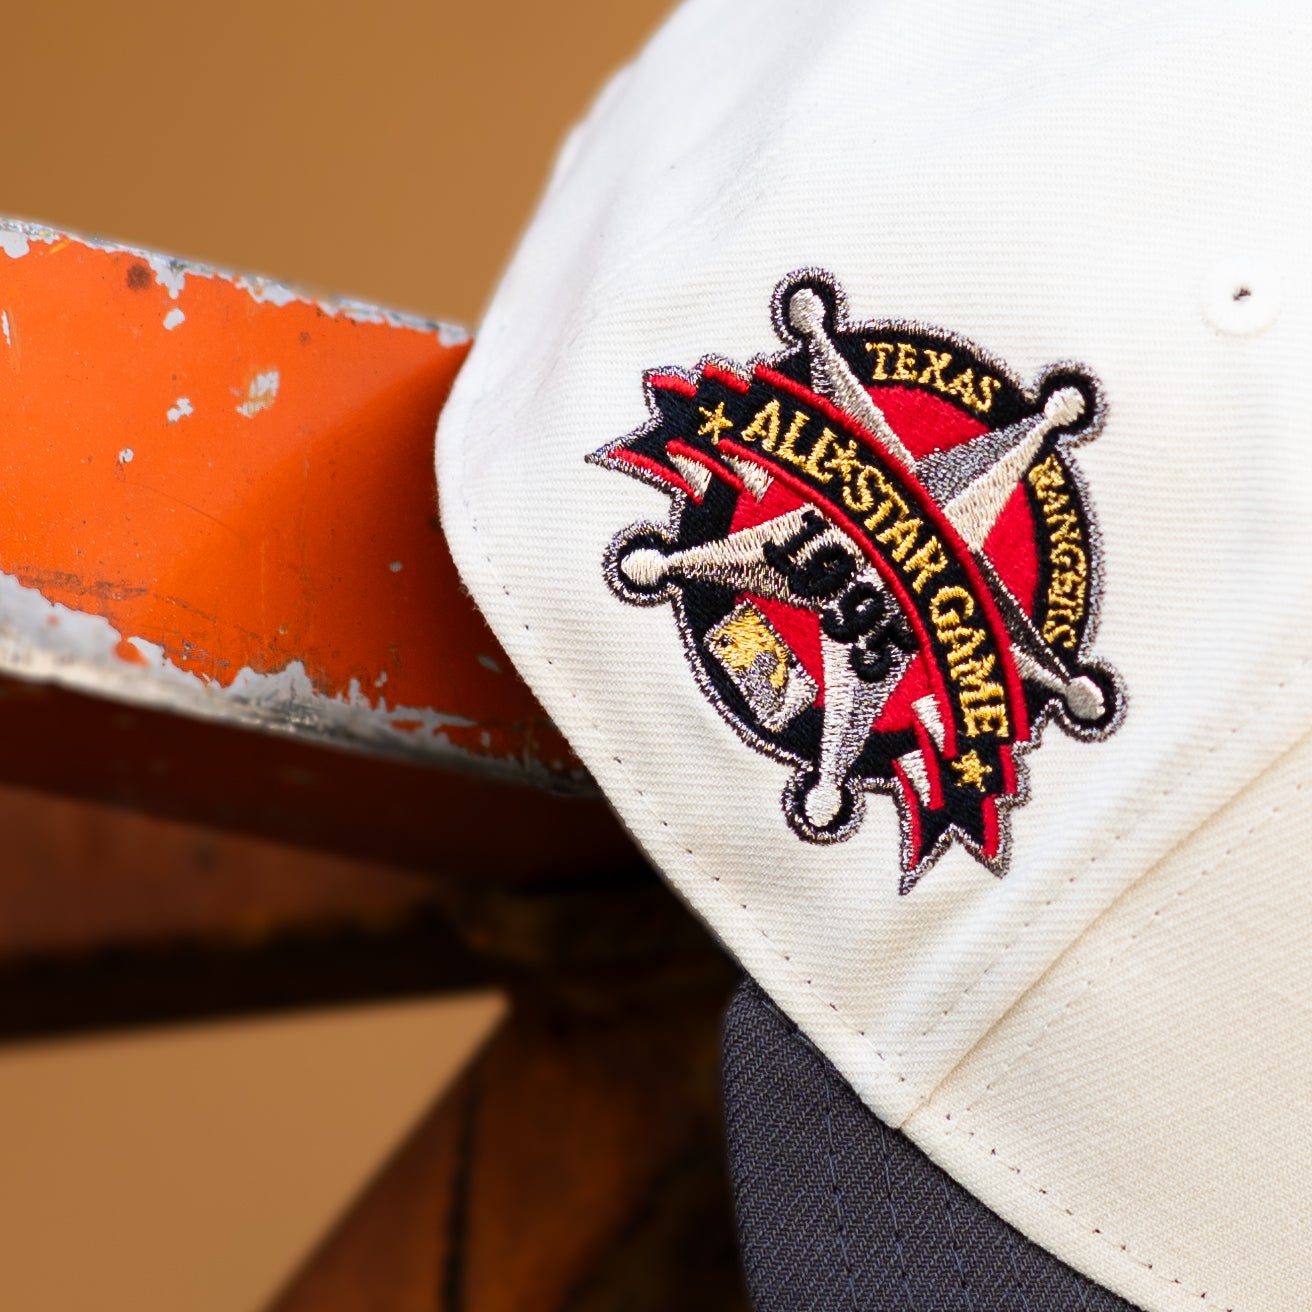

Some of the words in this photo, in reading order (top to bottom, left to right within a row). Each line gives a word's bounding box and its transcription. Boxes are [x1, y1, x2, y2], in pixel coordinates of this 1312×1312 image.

[865, 342, 1001, 413] TEXAS
[762, 509, 920, 683] 1995
[1028, 453, 1087, 650] RANGERS
[929, 585, 1009, 738] GAME
